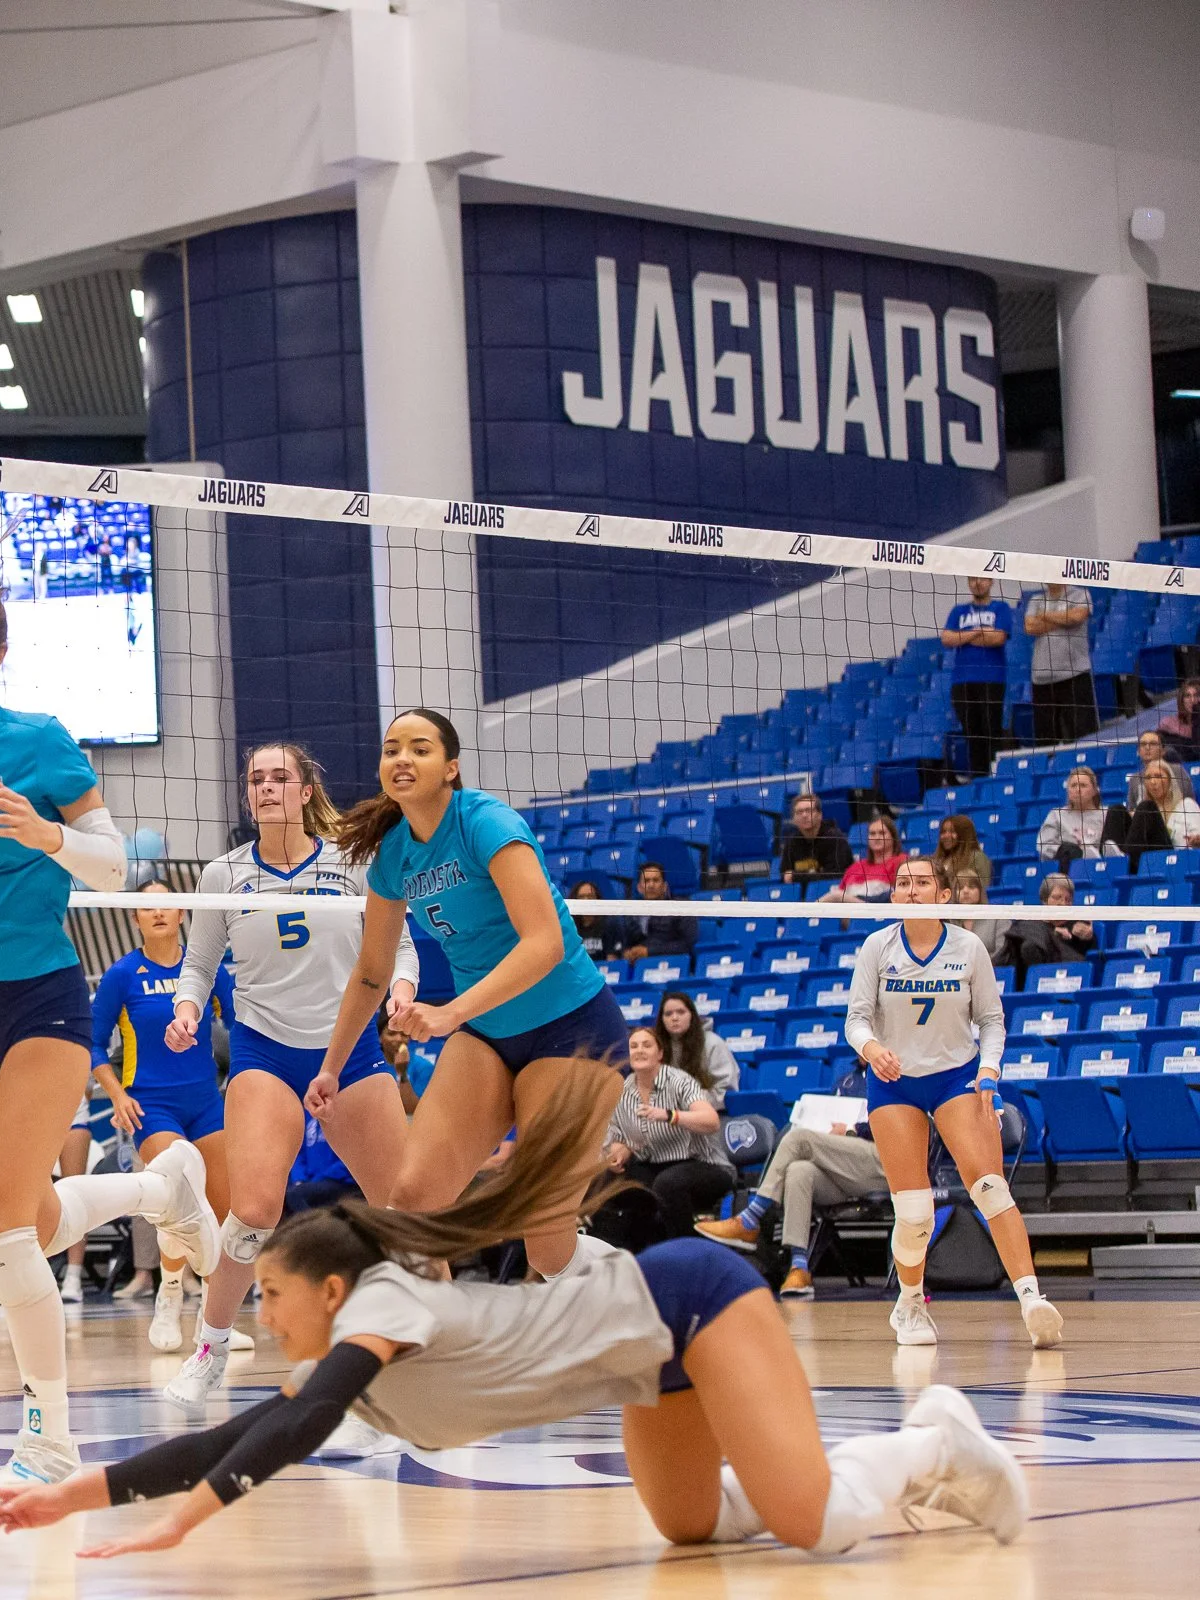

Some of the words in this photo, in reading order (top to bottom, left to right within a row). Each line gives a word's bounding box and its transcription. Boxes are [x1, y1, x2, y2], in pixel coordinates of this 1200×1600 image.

[562, 256, 1000, 471] JAGUARS
[198, 480, 266, 508] JAGUARS
[444, 502, 505, 529] JAGUARS
[668, 523, 723, 548] JAGUARS
[872, 542, 925, 566] JAGUARS
[1062, 559, 1109, 581] JAGUARS
[276, 911, 311, 949] 5
[142, 978, 180, 995] LAN
[885, 979, 961, 993] BEARCATS
[911, 997, 935, 1026] 7
